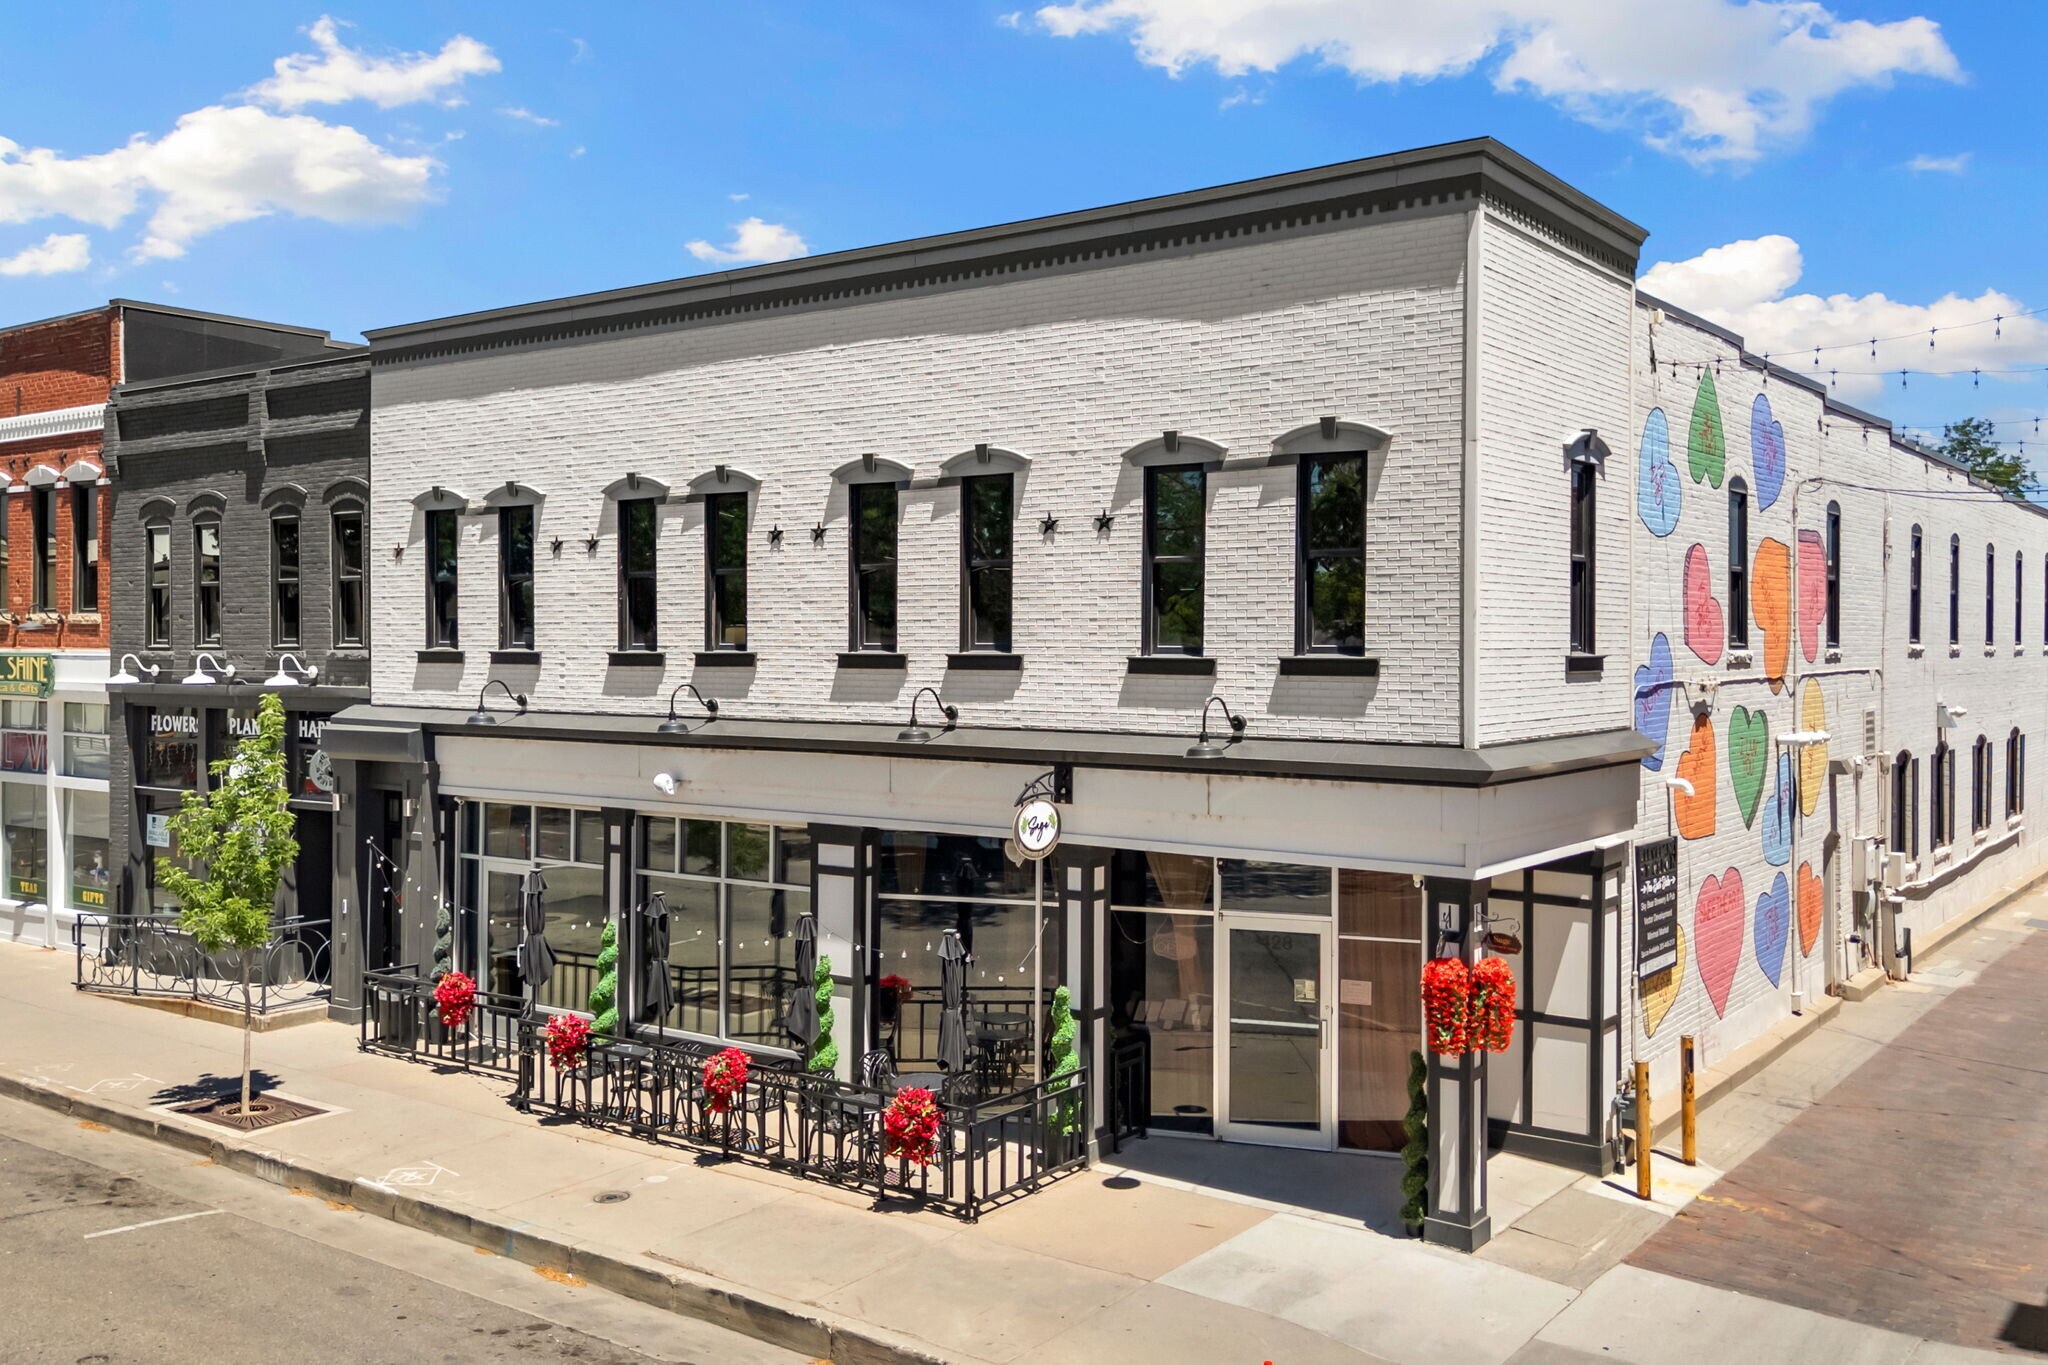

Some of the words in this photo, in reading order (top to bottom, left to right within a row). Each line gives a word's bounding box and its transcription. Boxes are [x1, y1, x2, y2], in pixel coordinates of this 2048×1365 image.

[7, 656, 48, 683] SHINE
[229, 717, 261, 735] PLAN
[1028, 816, 1050, 842] Sage
[20, 881, 38, 893] TEAS
[82, 891, 104, 904] GIFTS
